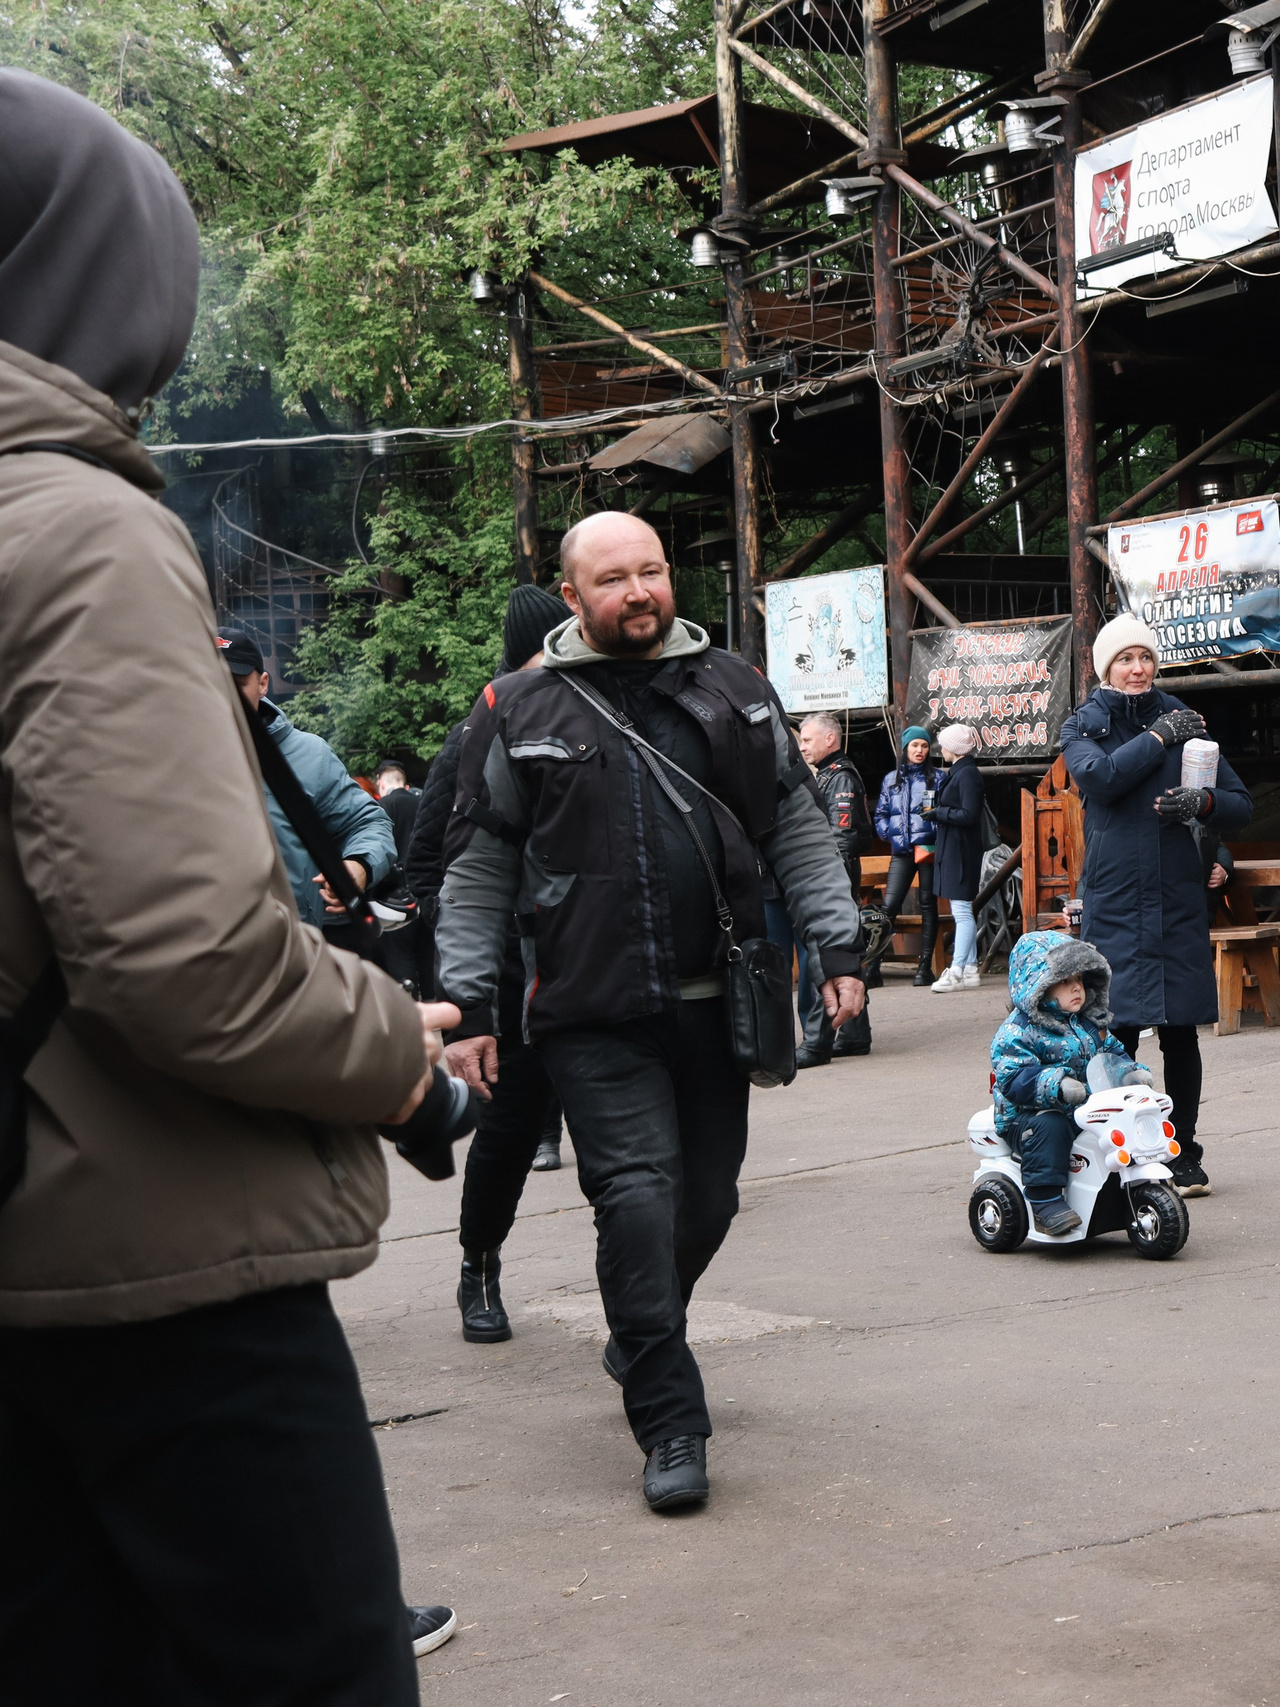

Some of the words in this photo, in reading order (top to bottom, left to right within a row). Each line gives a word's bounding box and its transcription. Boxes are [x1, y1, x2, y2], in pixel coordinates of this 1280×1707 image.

[1137, 124, 1241, 179] Департамент
[1137, 178, 1191, 208] спорта
[1138, 212, 1196, 241] города
[1196, 189, 1256, 226] Москвы
[1177, 522, 1209, 563] 26
[1156, 564, 1220, 593] АПРЕЛЯ
[1144, 593, 1233, 623] ОТКРЫТИЕ
[954, 632, 1025, 658] ДЕТСКИЕ
[1151, 616, 1247, 648] ОТОСЕЗОНА
[928, 666, 961, 691] ДНИ
[967, 658, 1051, 687] РОЖДЕНИЯ
[838, 813, 850, 828] Z
